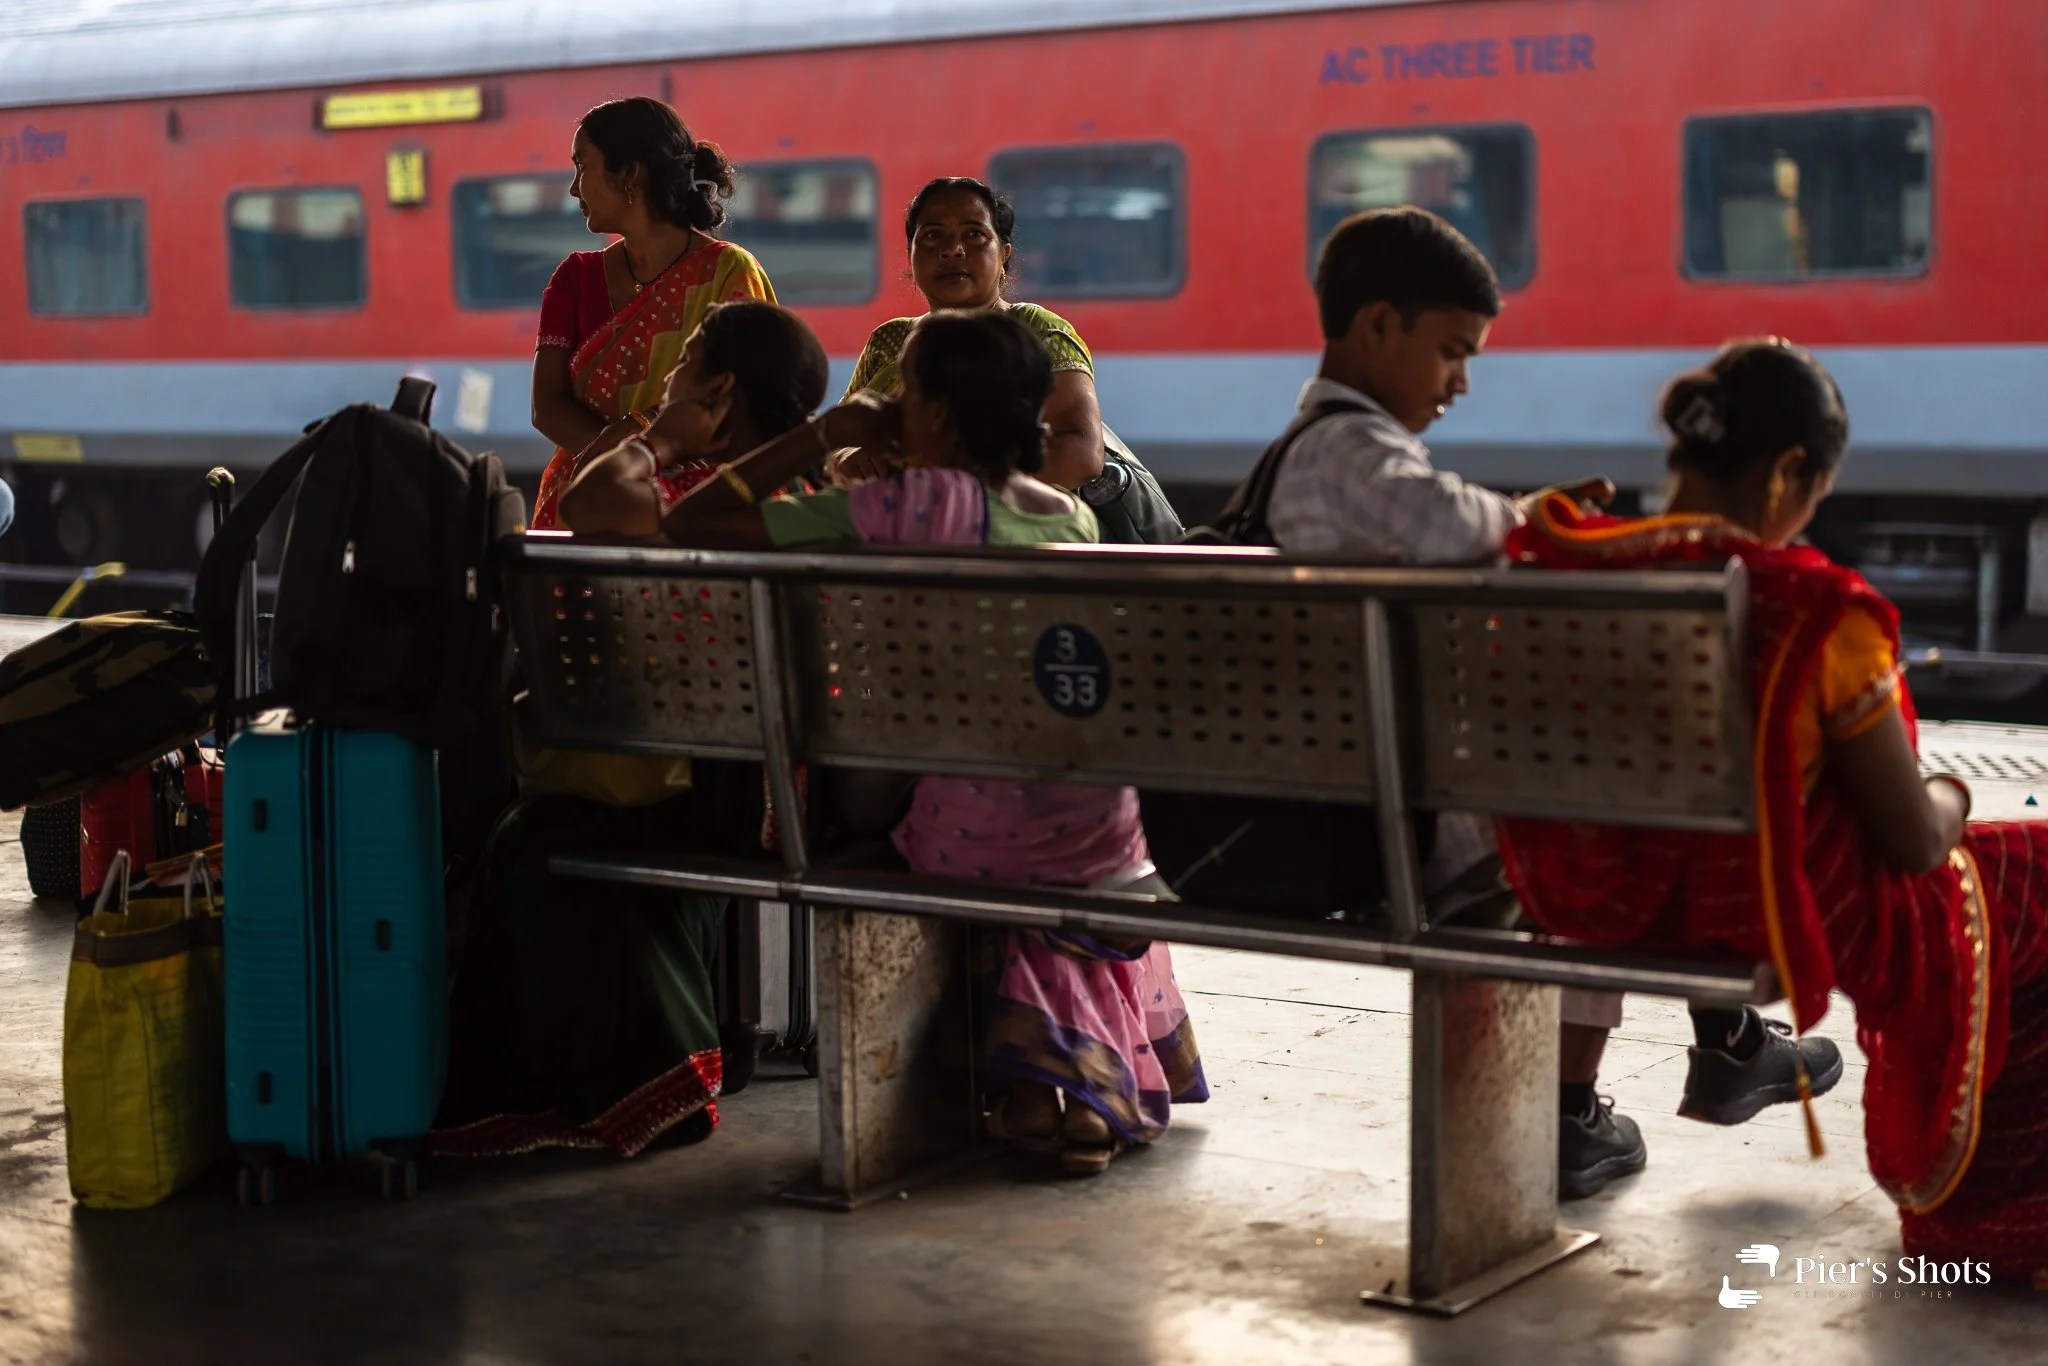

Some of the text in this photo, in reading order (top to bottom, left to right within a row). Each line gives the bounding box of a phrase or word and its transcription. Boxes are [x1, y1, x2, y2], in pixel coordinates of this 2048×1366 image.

[1319, 32, 1595, 85] AC THREE TIER
[1055, 628, 1077, 663] 3
[1053, 674, 1097, 707] 33
